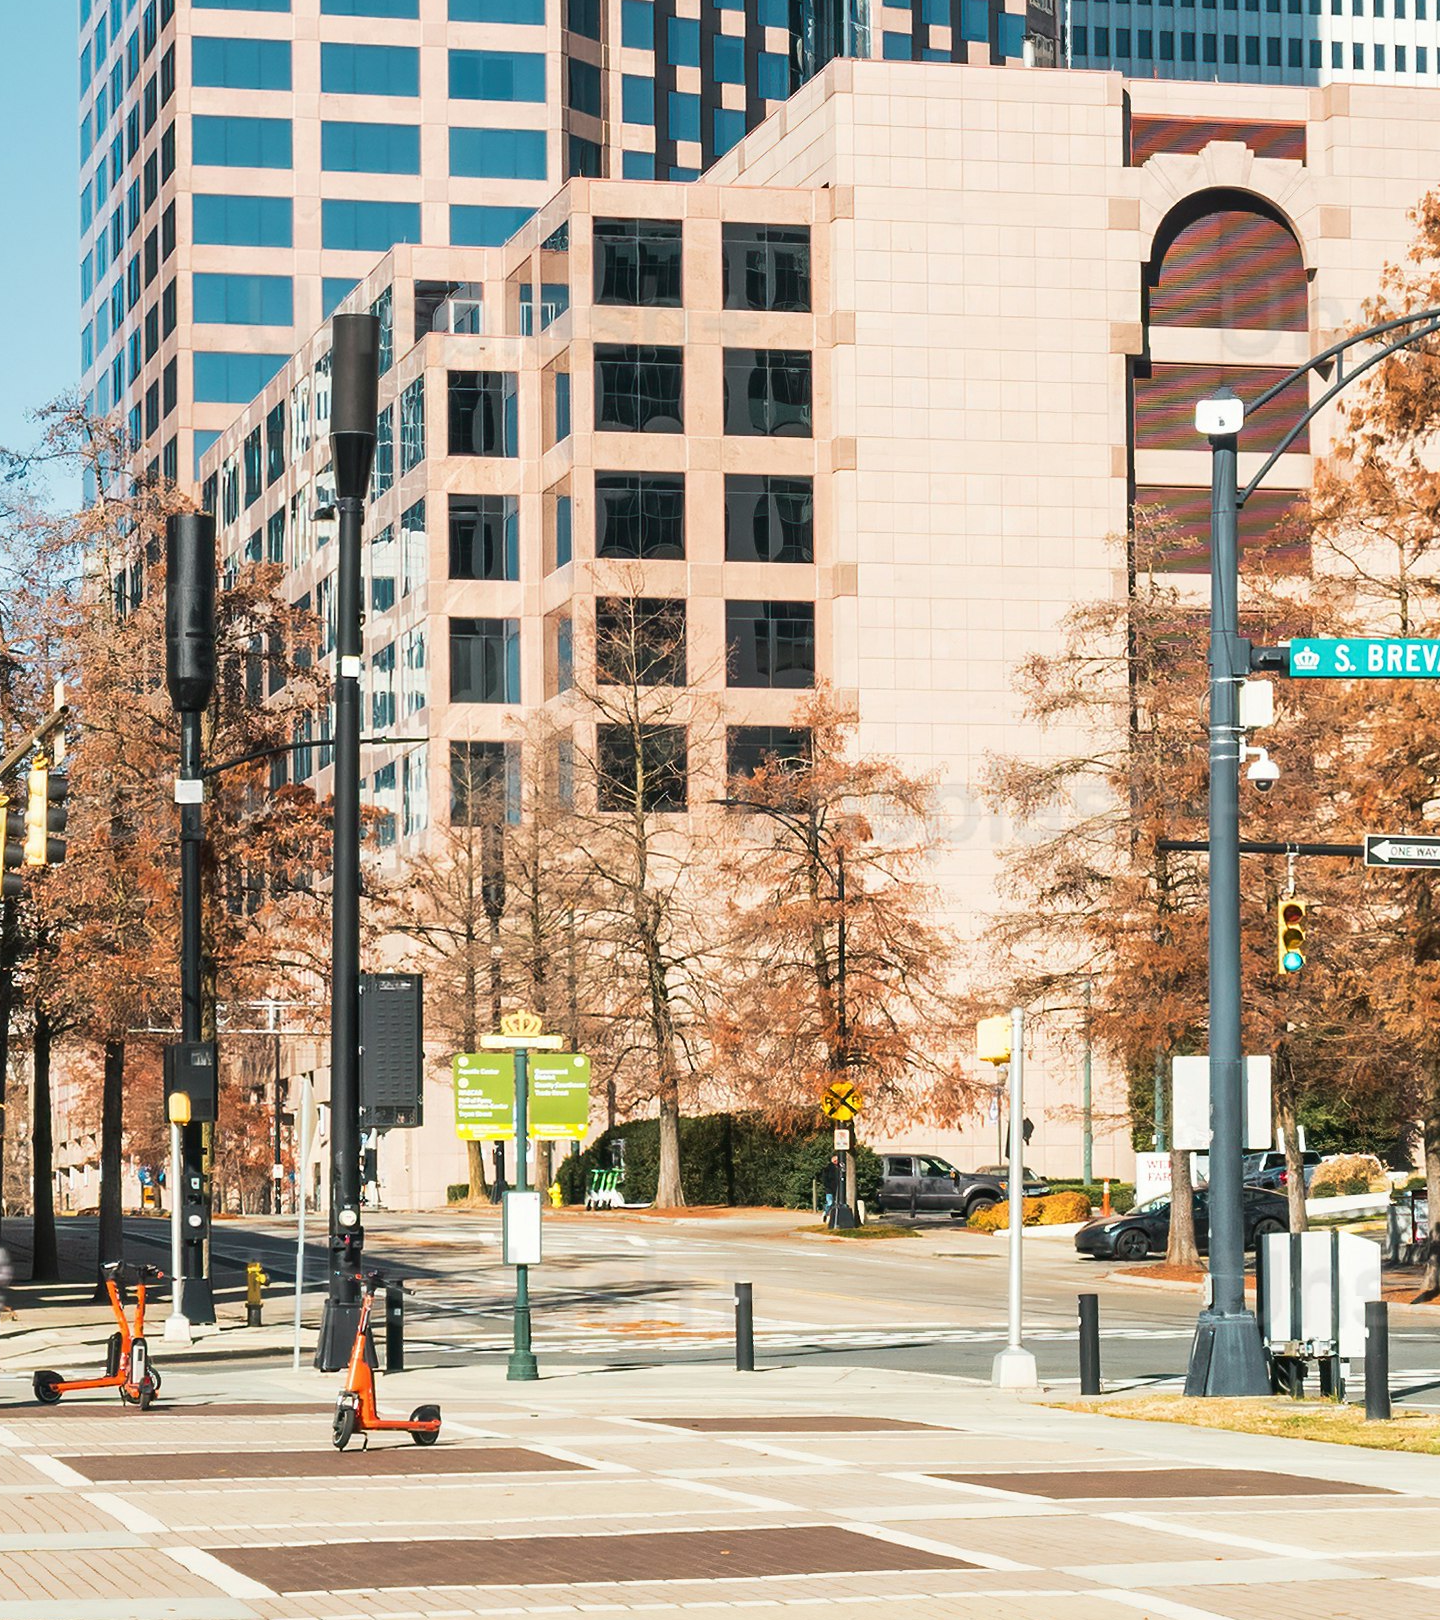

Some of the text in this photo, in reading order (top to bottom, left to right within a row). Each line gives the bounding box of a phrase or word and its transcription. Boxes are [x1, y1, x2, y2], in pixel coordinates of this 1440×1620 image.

[1335, 645, 1356, 672] S.
[1391, 847, 1439, 857] ONE WAY
